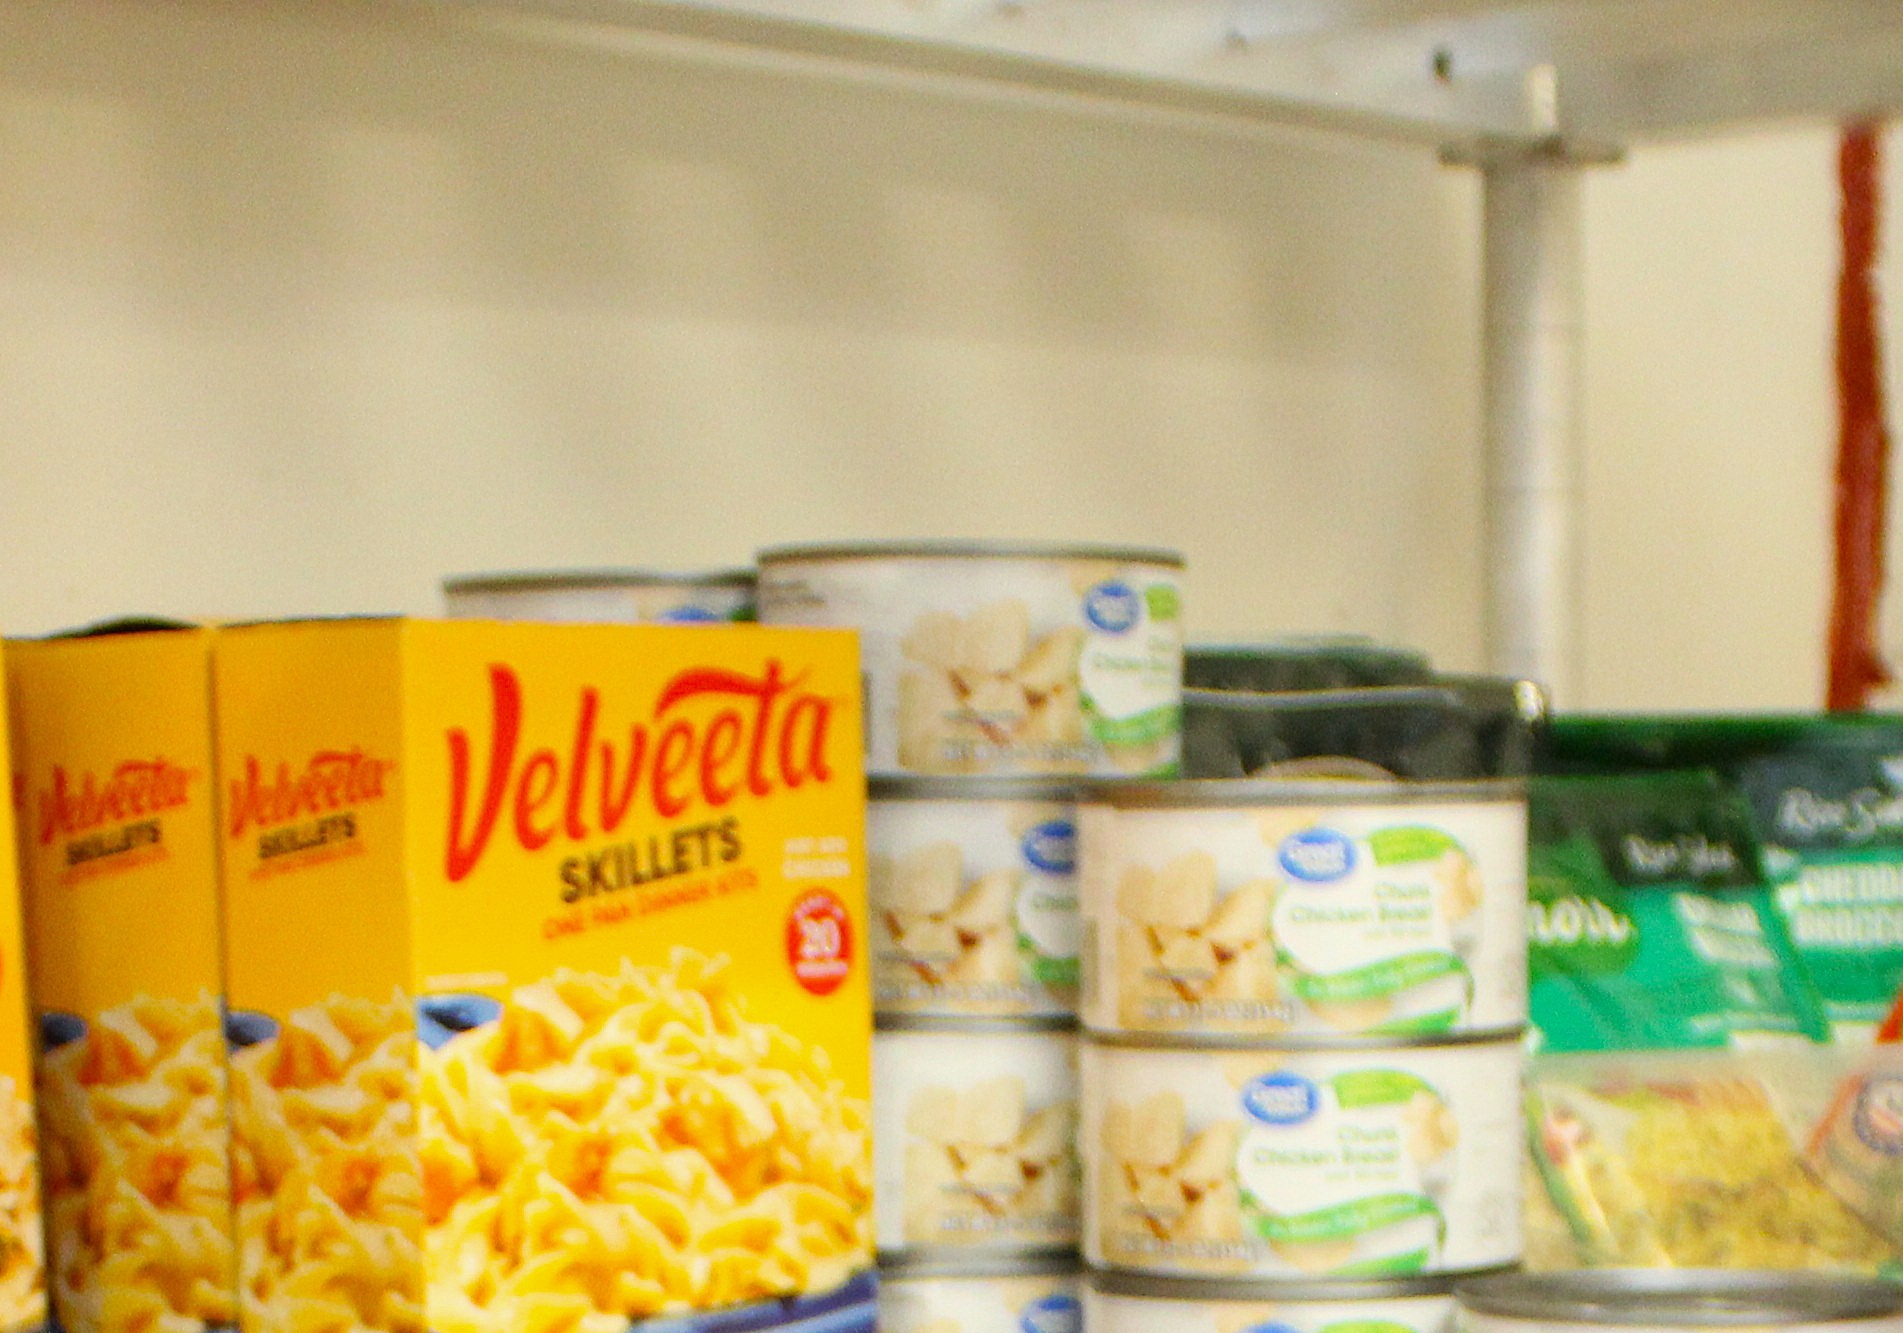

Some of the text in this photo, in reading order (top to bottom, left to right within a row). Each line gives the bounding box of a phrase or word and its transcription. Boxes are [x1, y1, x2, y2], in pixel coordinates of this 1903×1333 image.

[445, 659, 834, 884] Velveeta
[65, 817, 161, 866] SKILLETS
[258, 811, 358, 859] SKILLETS
[561, 815, 743, 903] SKILLETS
[1527, 894, 1638, 946] norr
